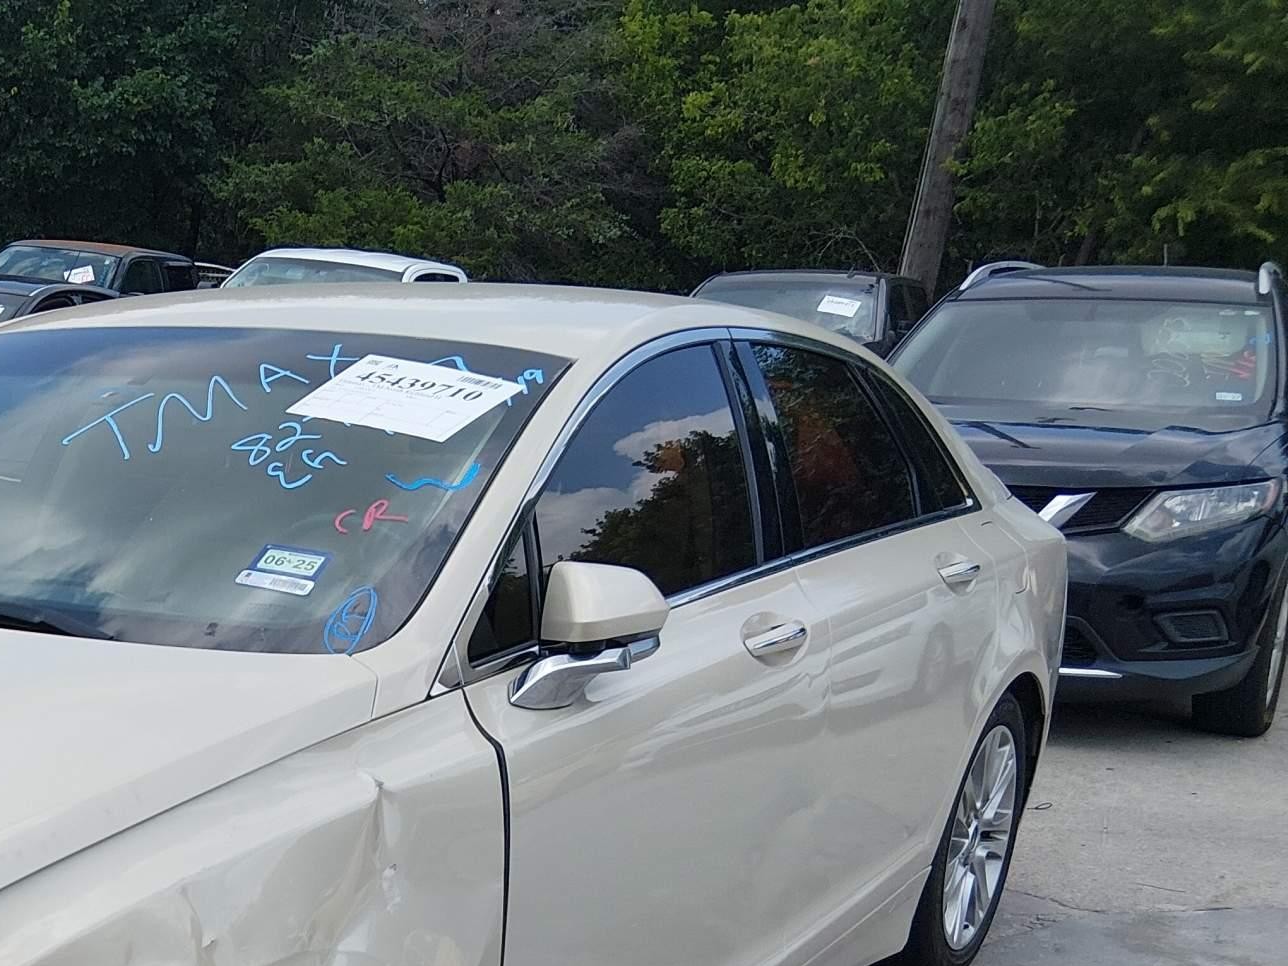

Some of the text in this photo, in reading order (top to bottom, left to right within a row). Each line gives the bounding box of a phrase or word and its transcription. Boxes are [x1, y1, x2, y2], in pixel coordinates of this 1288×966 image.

[356, 371, 483, 401] 45439710
[263, 554, 318, 571] 06 25
